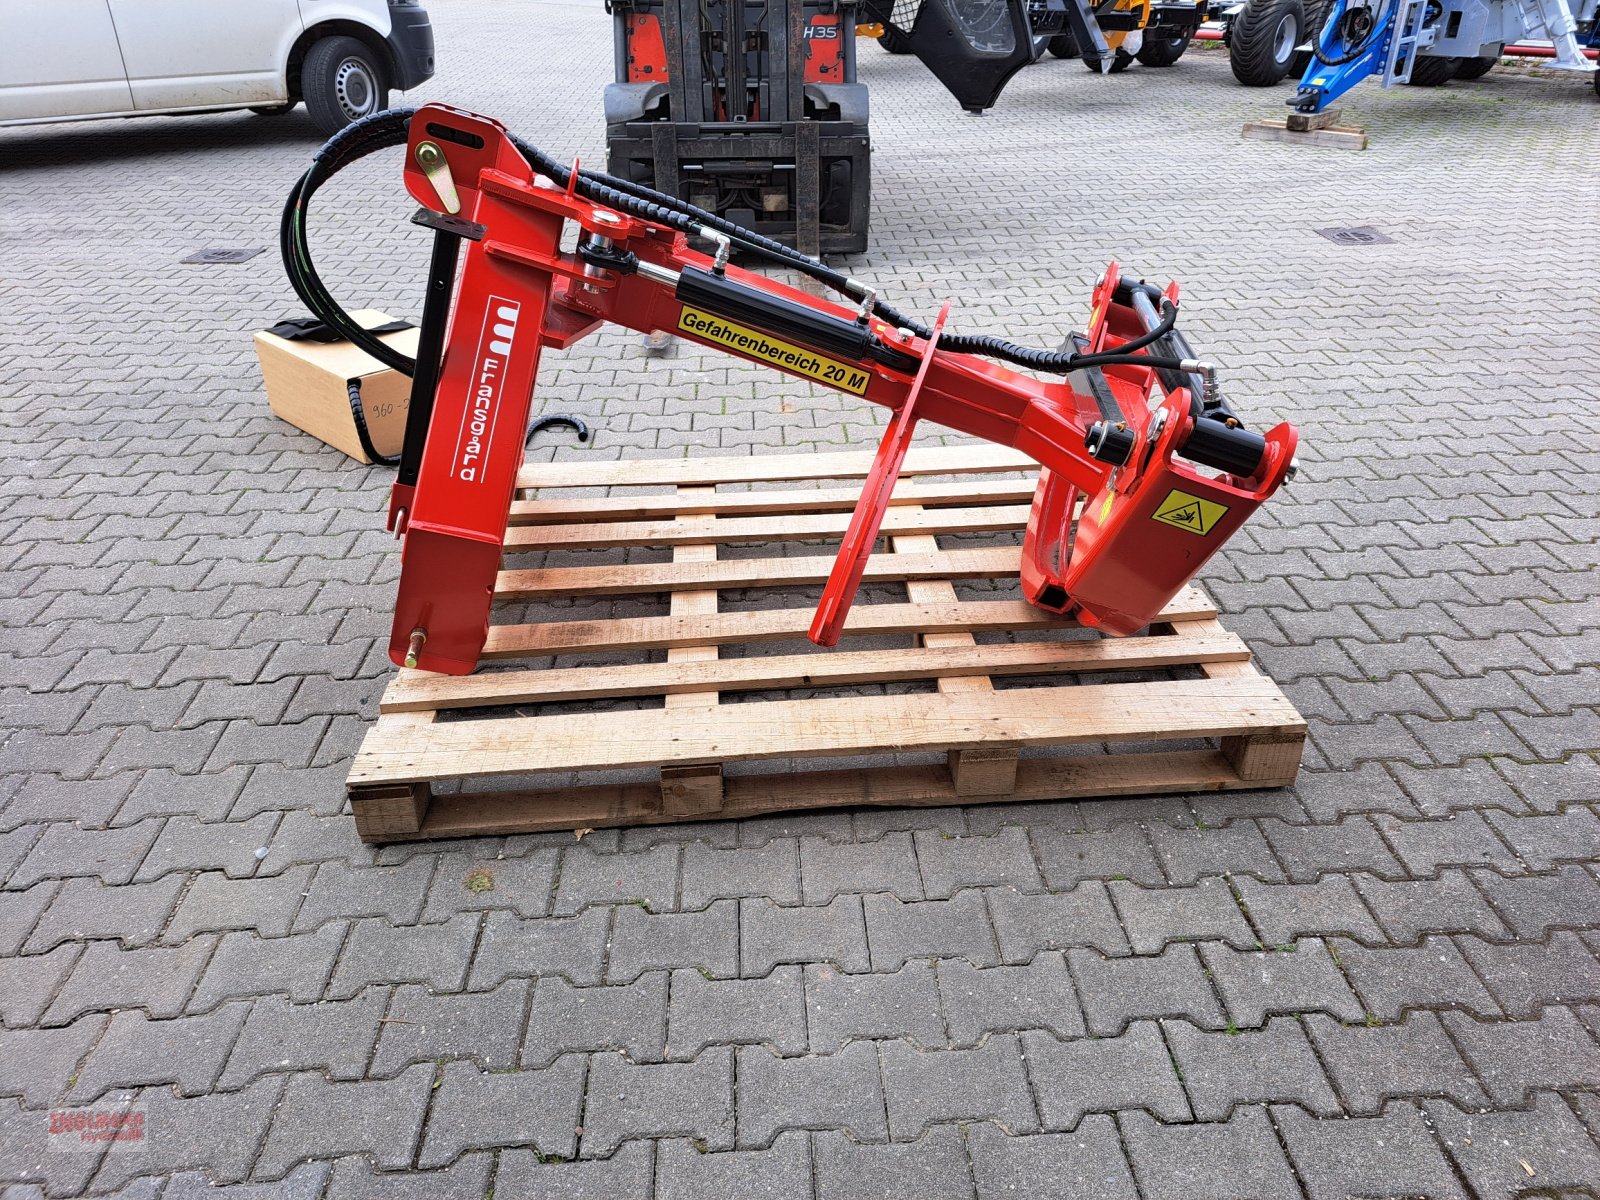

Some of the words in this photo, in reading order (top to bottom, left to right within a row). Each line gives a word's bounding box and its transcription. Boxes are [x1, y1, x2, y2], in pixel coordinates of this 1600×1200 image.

[683, 312, 821, 374] Gefahrenbereich
[823, 365, 846, 382] 20
[847, 372, 866, 390] M
[460, 358, 499, 482] Fransgård
